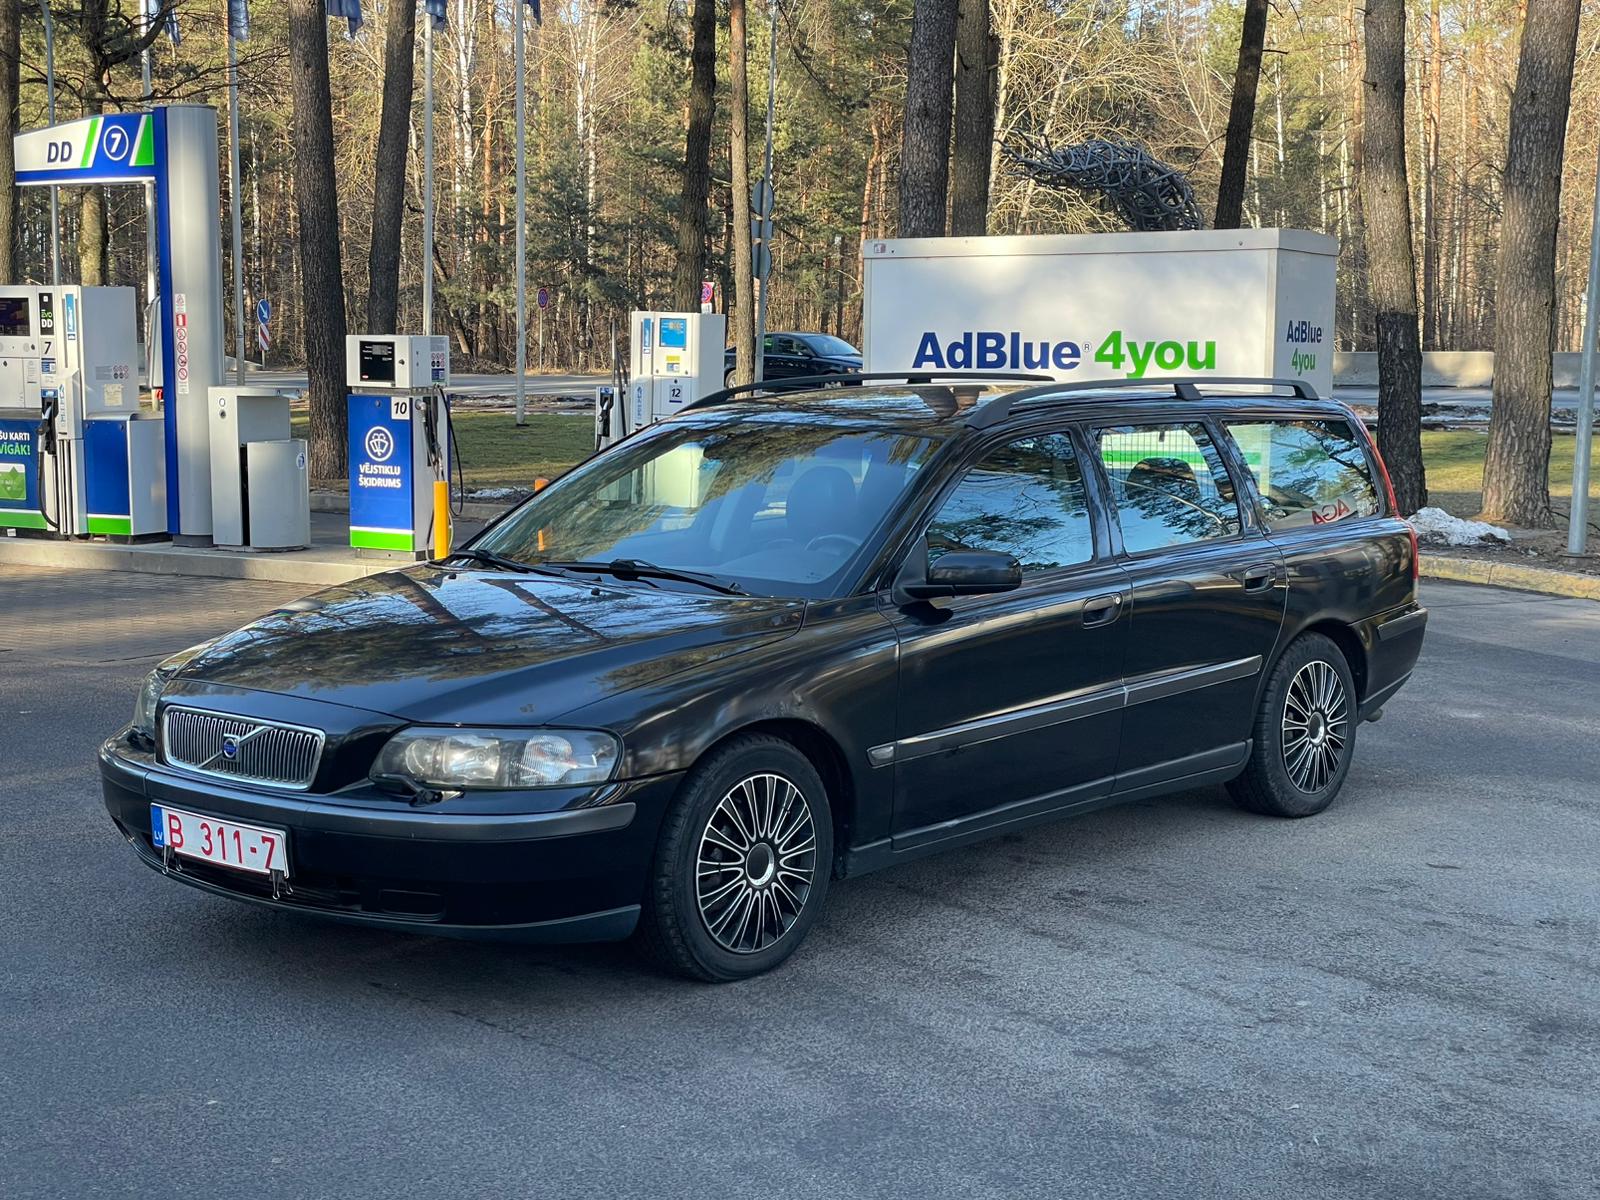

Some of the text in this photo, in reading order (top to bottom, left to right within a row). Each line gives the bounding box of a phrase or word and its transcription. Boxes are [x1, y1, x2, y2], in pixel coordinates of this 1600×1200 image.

[110, 134, 121, 153] 7
[47, 141, 73, 163] DD
[41, 319, 53, 328] DD
[44, 341, 52, 355] 7
[1094, 330, 1217, 379] 4you
[1291, 347, 1316, 377] 4you
[671, 388, 681, 398] 12
[394, 402, 407, 415] 10
[9, 432, 30, 441] KARTI
[154, 830, 163, 842] LV
[167, 813, 275, 870] B 311-7
